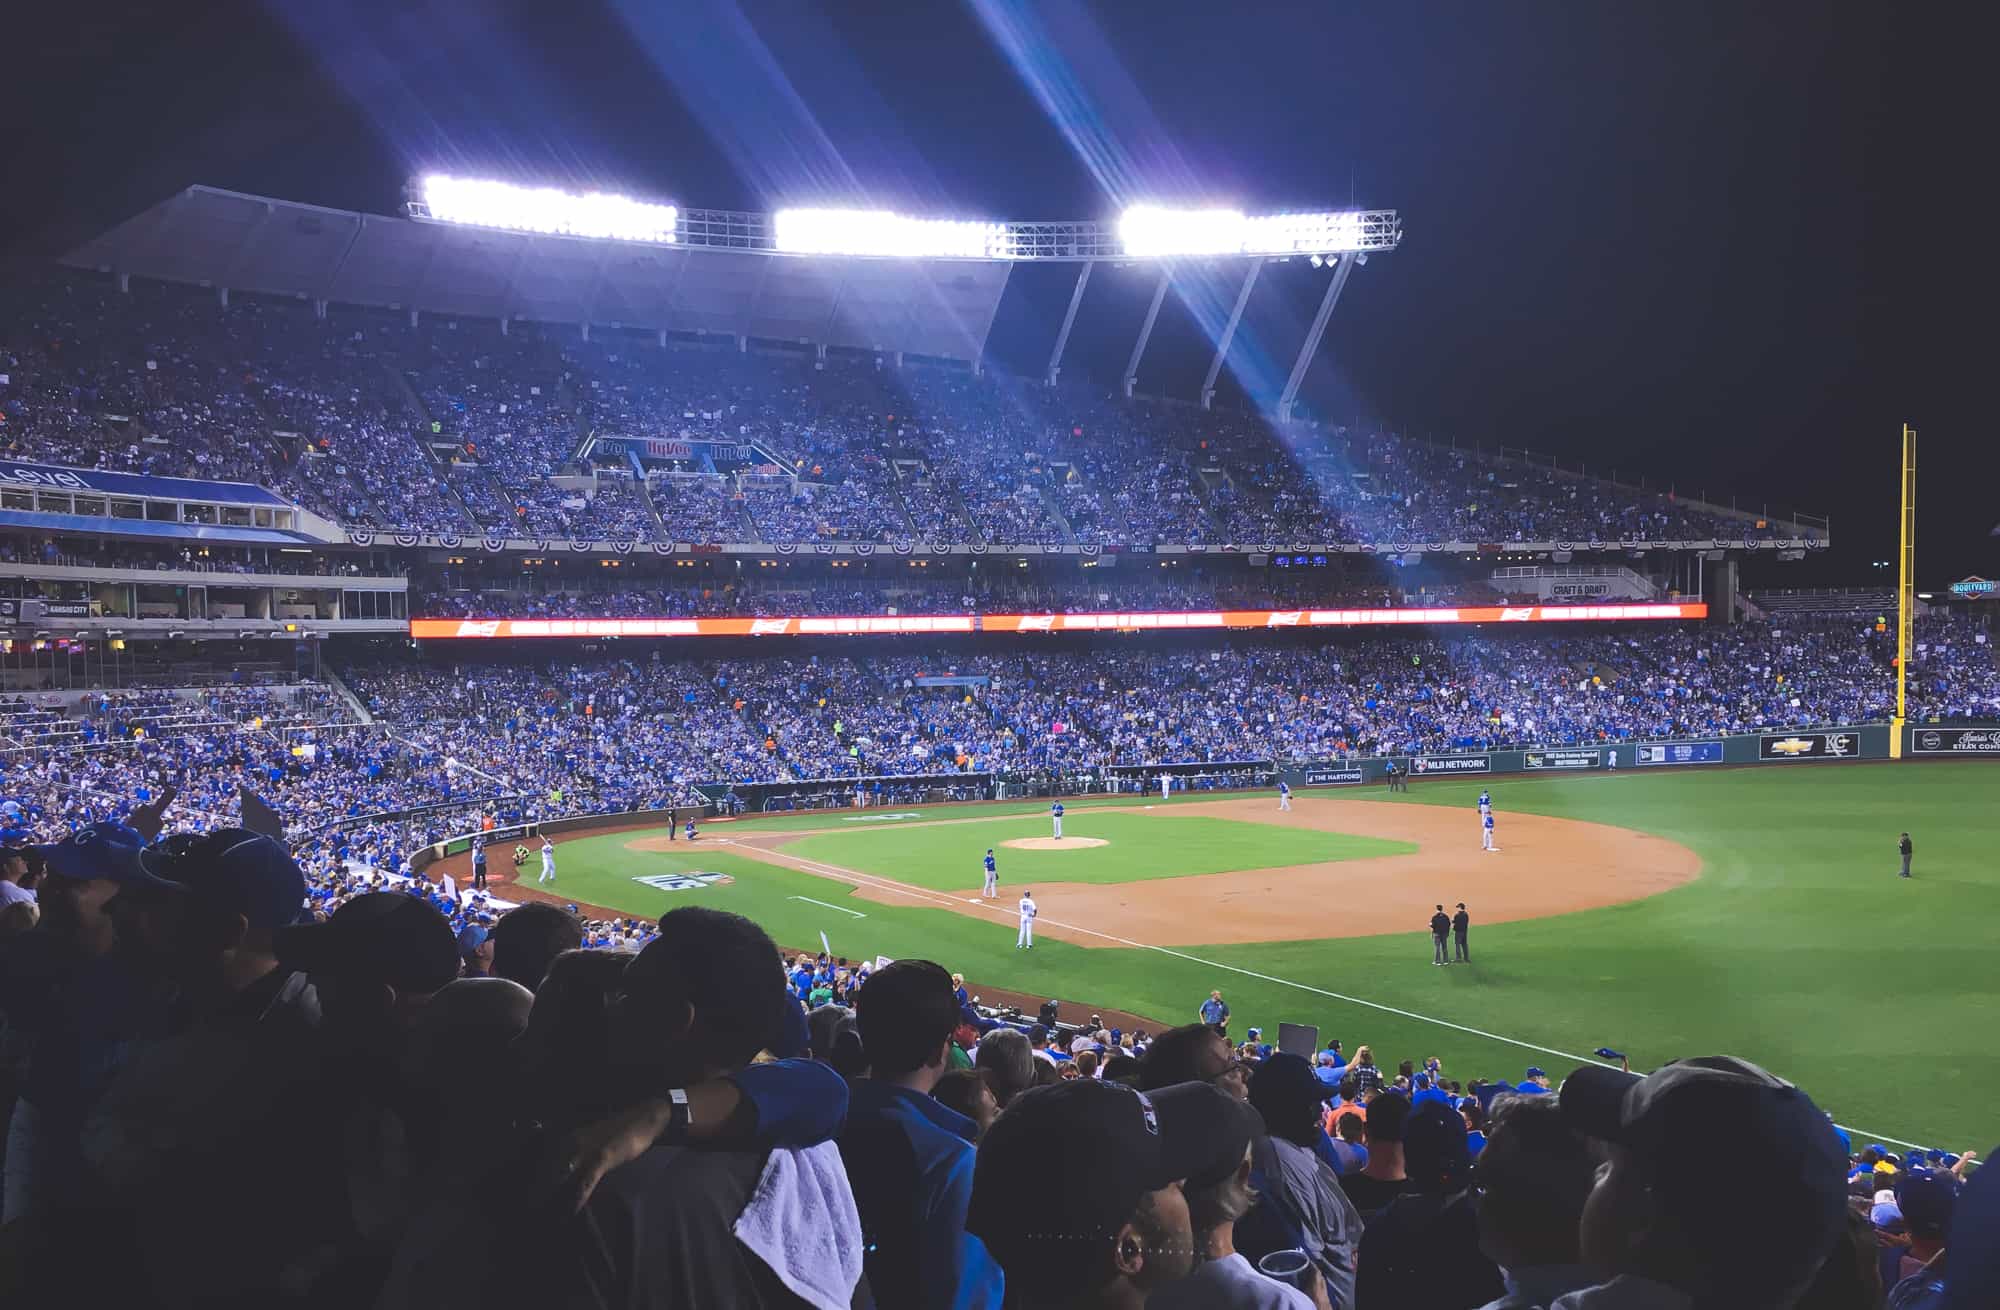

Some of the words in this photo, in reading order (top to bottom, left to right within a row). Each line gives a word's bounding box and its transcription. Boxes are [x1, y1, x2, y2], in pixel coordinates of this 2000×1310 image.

[1553, 585, 1576, 595] CRAFT
[1584, 585, 1606, 594] DRAFT
[1428, 761, 1445, 769] MLB
[1445, 759, 1486, 769] NETWORK
[1327, 772, 1361, 781] HARTFORD
